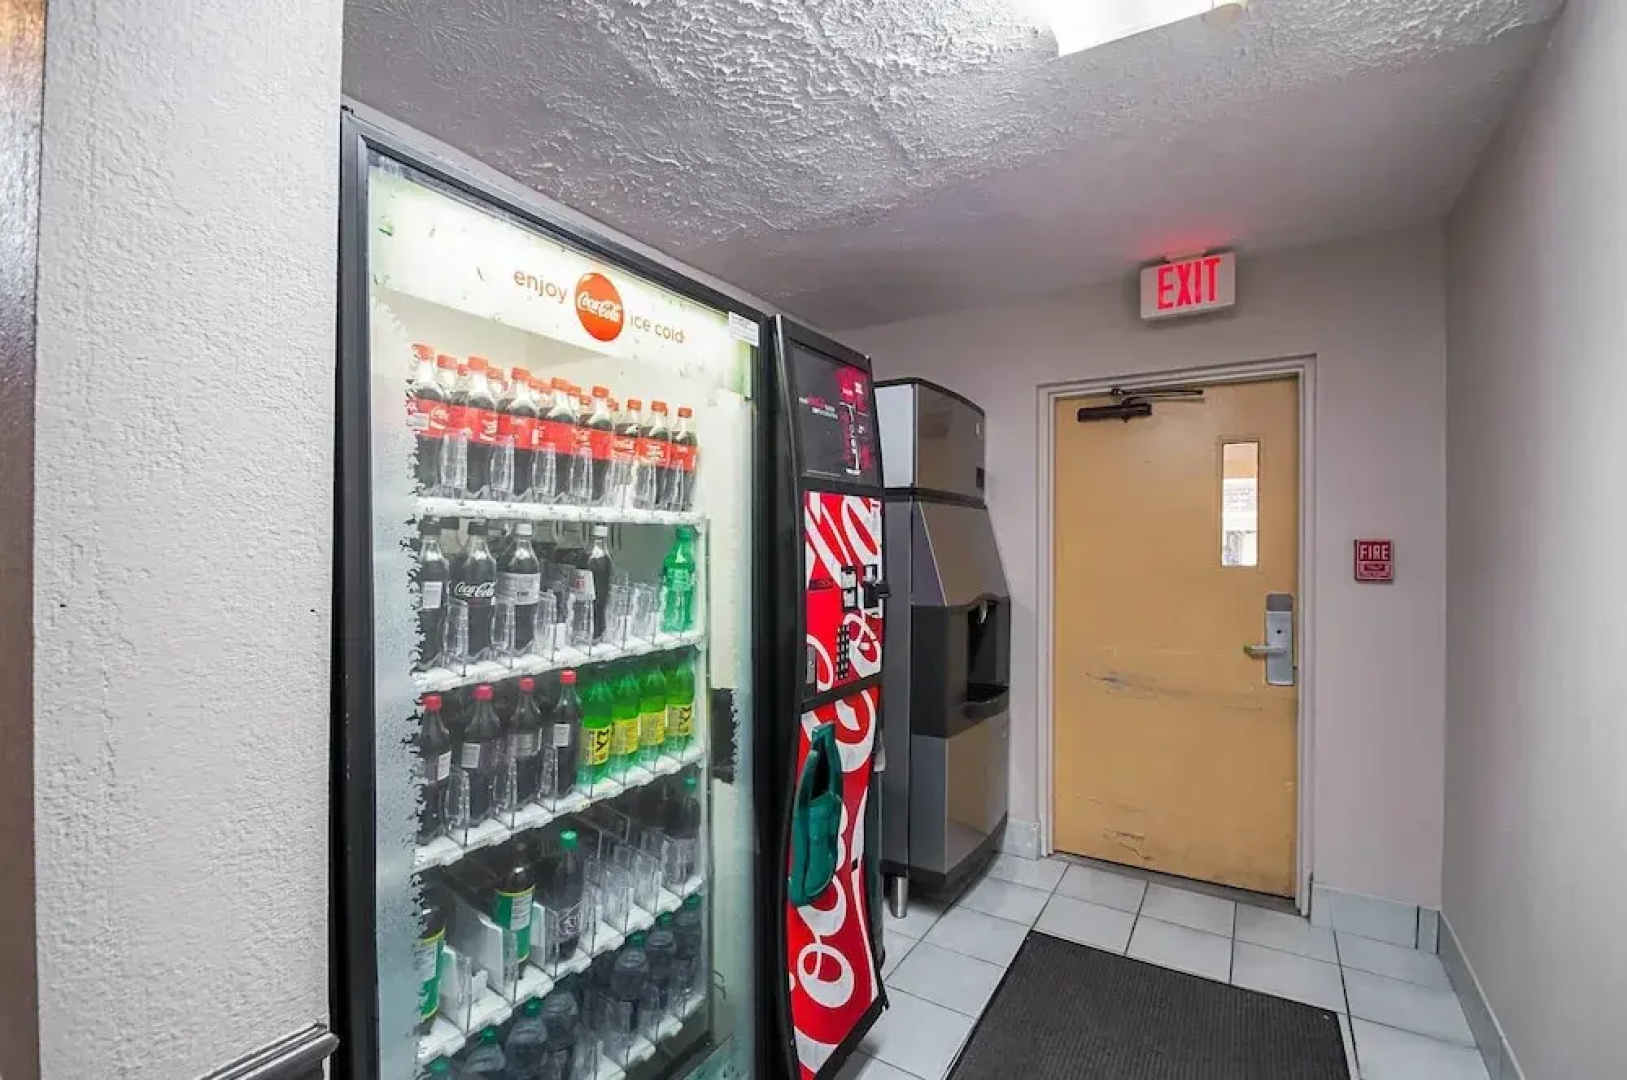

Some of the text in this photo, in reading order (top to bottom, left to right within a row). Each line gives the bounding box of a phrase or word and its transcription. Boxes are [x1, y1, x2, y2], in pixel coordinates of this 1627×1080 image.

[513, 270, 567, 304] enjoy
[630, 313, 652, 332] ice
[654, 323, 686, 344] cold
[1157, 257, 1221, 310] EXIT
[1360, 544, 1389, 560] FIRE
